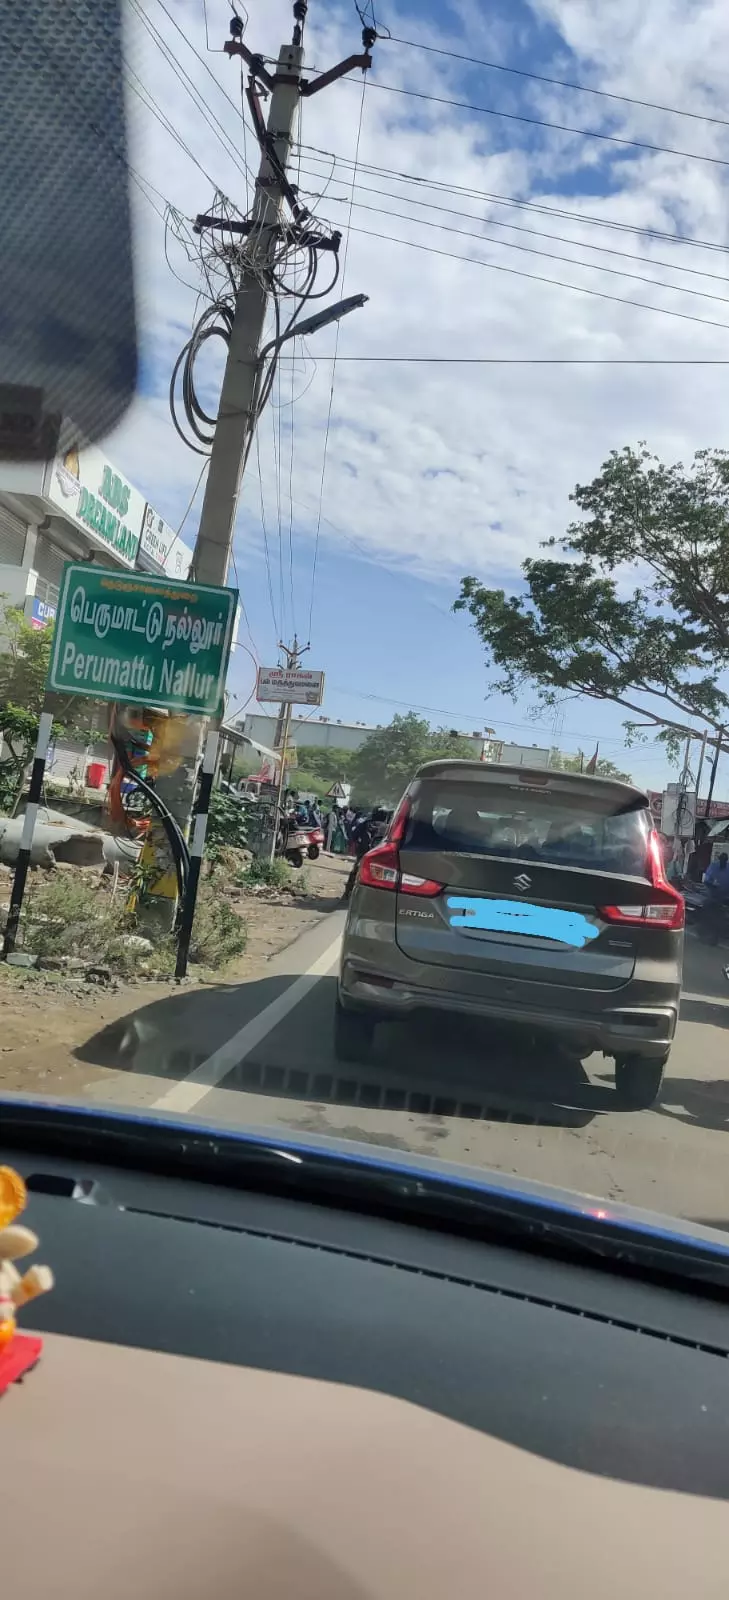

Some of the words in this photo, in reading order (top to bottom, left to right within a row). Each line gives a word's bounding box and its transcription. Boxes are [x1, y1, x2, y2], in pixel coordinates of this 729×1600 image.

[70, 585, 164, 644] பெருமாட்டு
[162, 605, 223, 655] நல்லூர்
[61, 641, 155, 691] Perumattu
[158, 657, 214, 701] Nallur
[398, 908, 434, 919] ERTIGA
